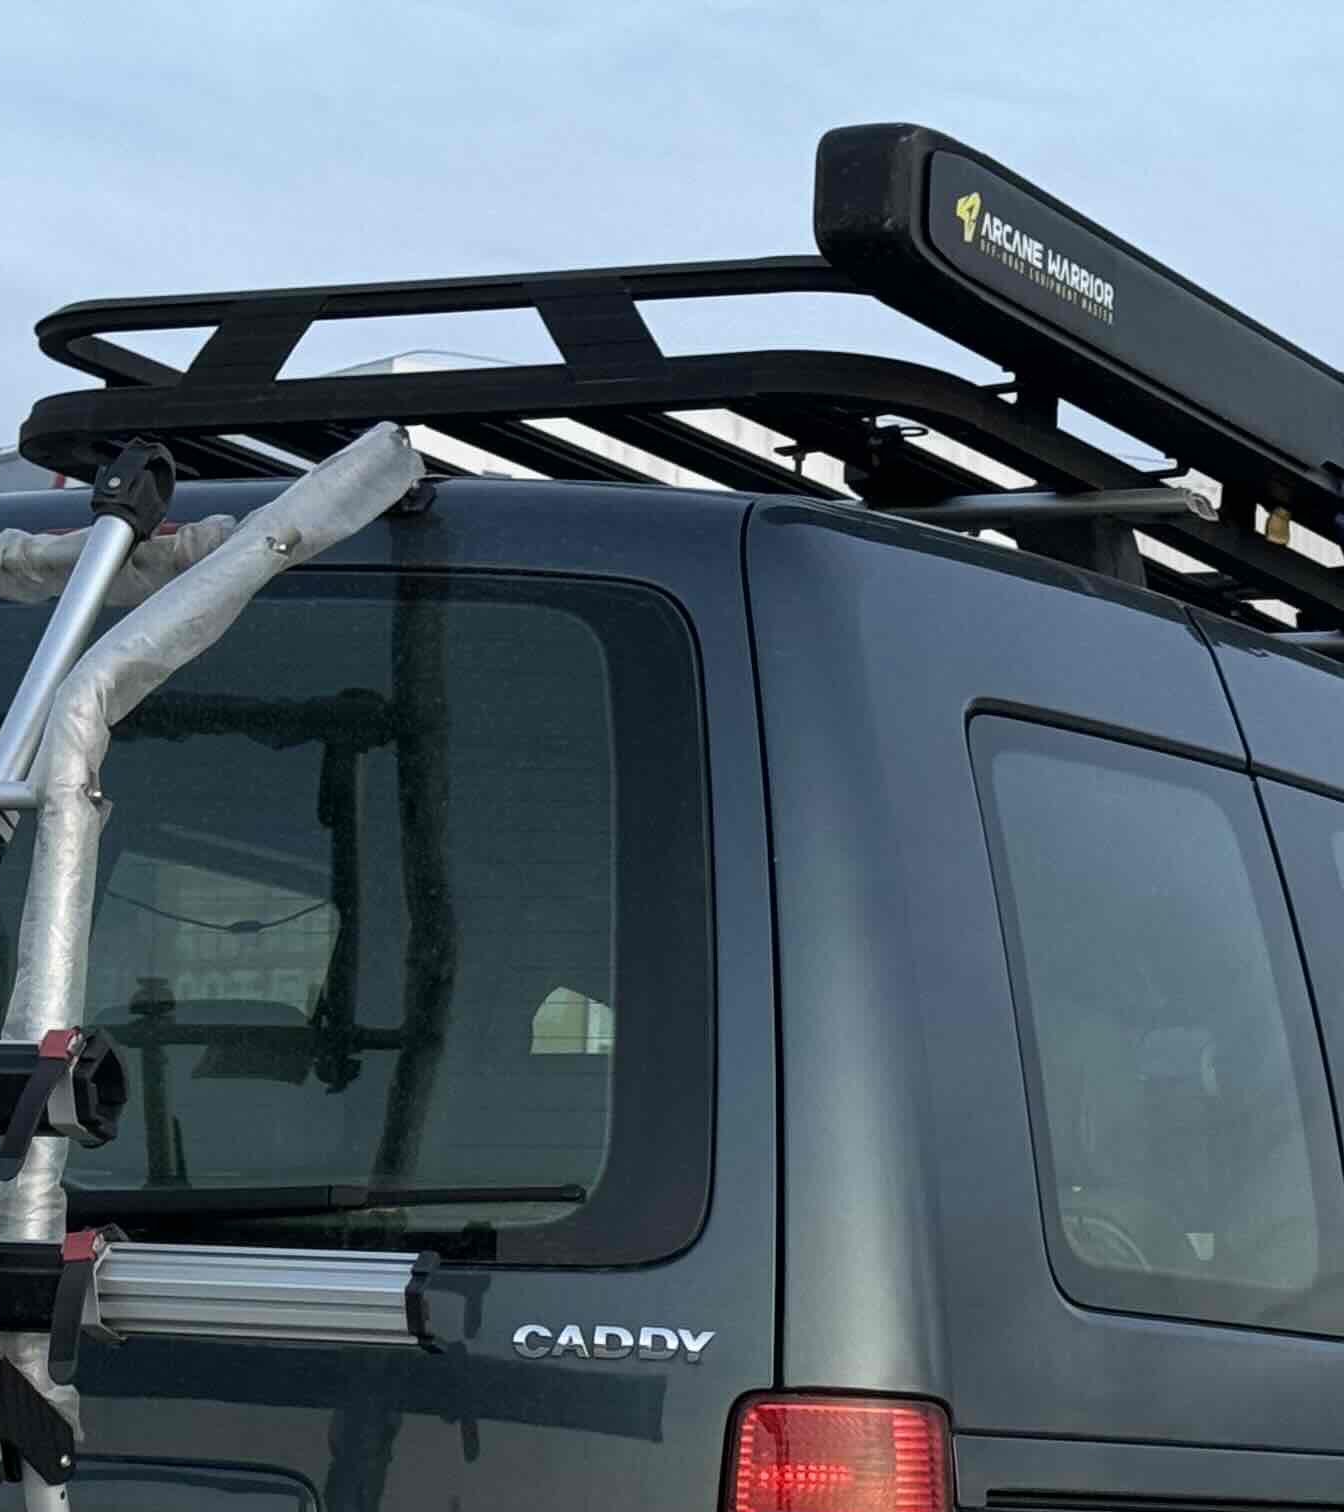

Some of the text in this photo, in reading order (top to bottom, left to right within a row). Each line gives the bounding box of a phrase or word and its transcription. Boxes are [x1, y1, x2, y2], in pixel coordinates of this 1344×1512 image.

[981, 212, 1114, 311] ARCANE WARRIOR
[511, 1323, 717, 1364] CADDY
